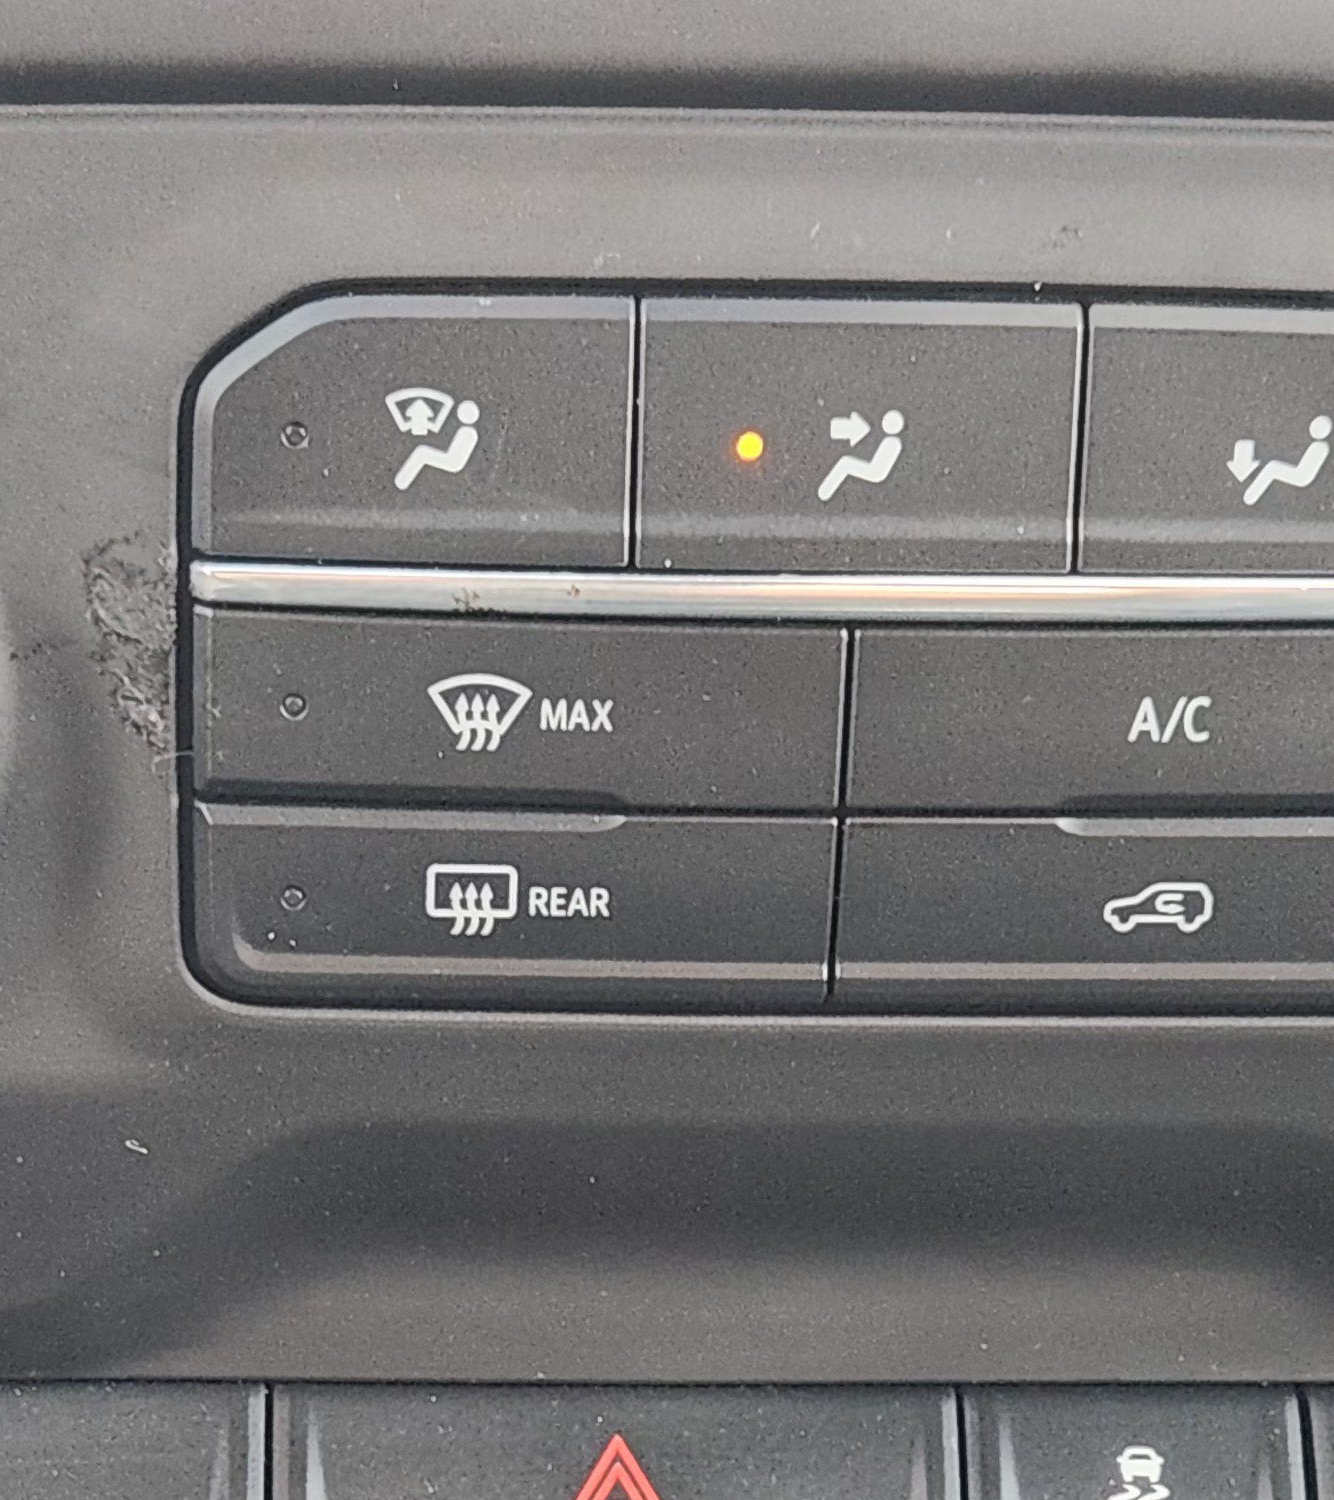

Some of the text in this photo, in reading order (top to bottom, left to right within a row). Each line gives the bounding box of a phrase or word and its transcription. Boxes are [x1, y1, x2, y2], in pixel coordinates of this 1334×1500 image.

[539, 697, 614, 733] MAX
[1127, 695, 1212, 744] A/C
[528, 886, 610, 918] REAR
